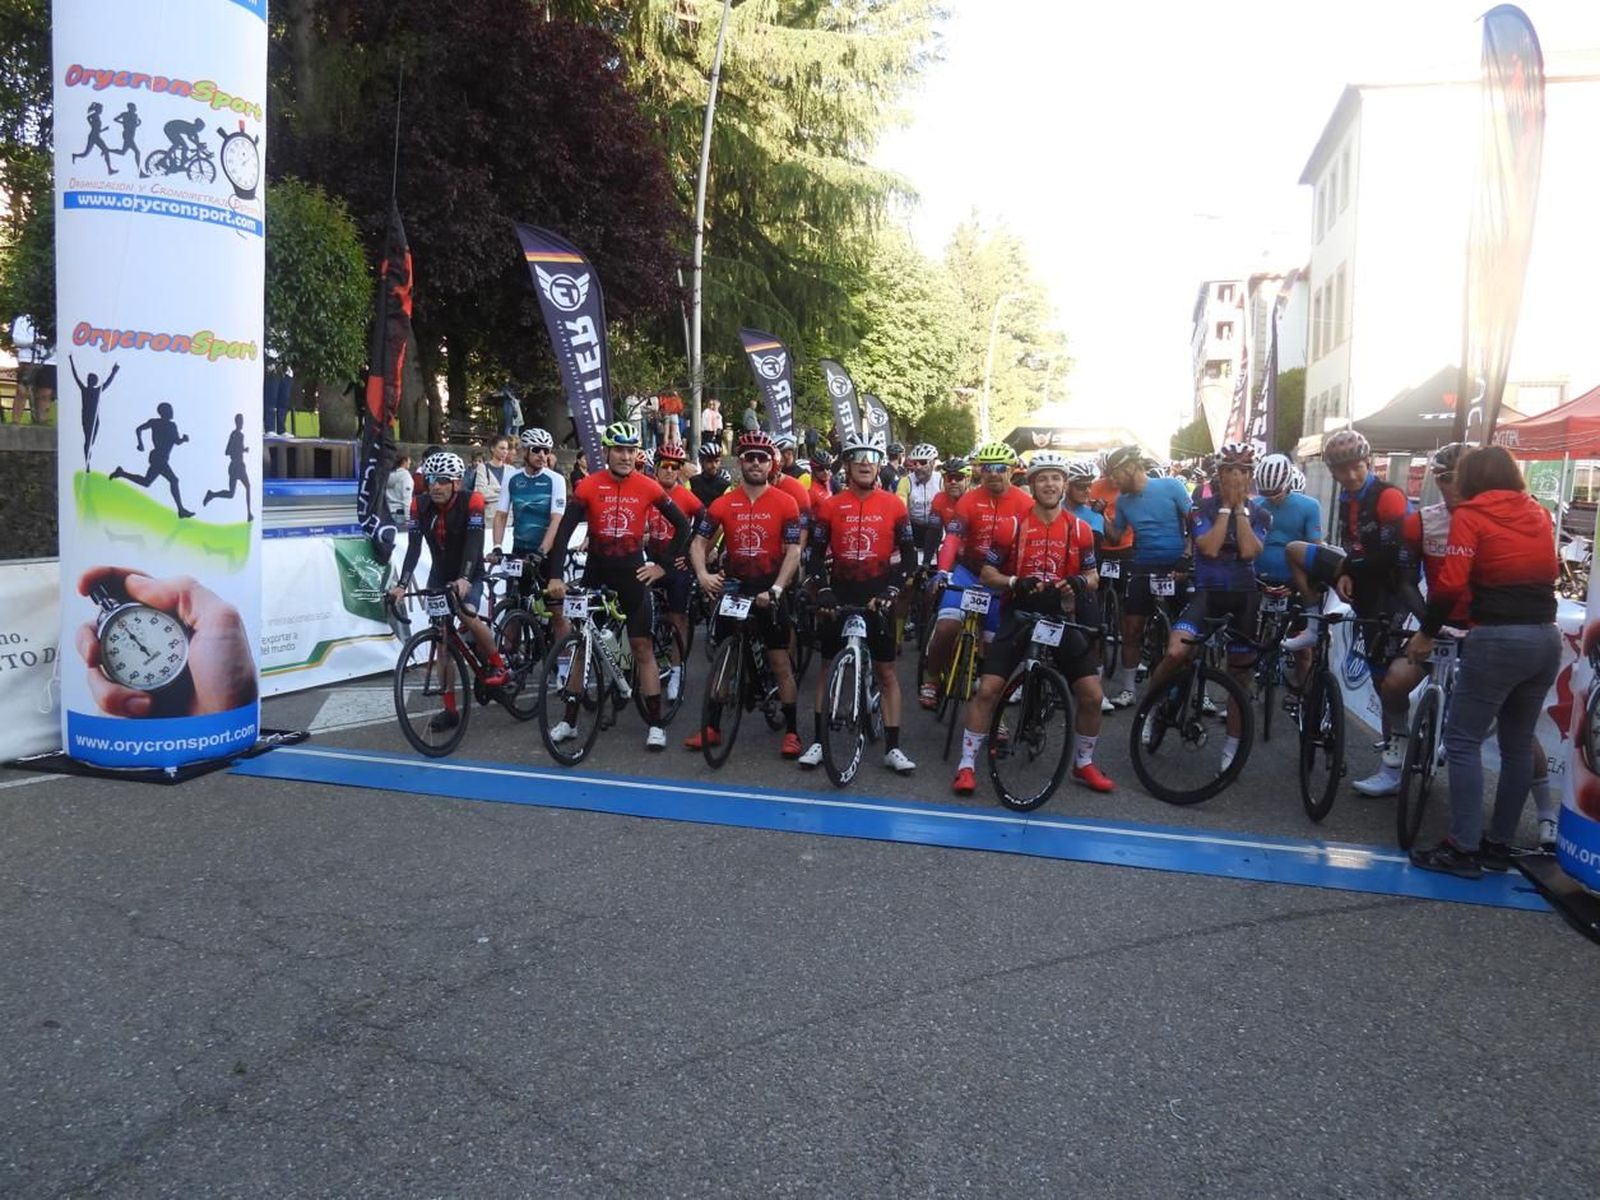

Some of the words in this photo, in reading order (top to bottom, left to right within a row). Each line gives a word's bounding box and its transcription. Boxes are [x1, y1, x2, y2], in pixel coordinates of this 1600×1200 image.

[65, 64, 262, 122] OrycronSport
[77, 194, 256, 231] www.orycronsport.com
[72, 321, 257, 361] OrycronSport
[570, 602, 582, 611] 74
[970, 596, 988, 607] 304
[1049, 629, 1057, 637] 7
[75, 723, 256, 755] www.orycronsport.com
